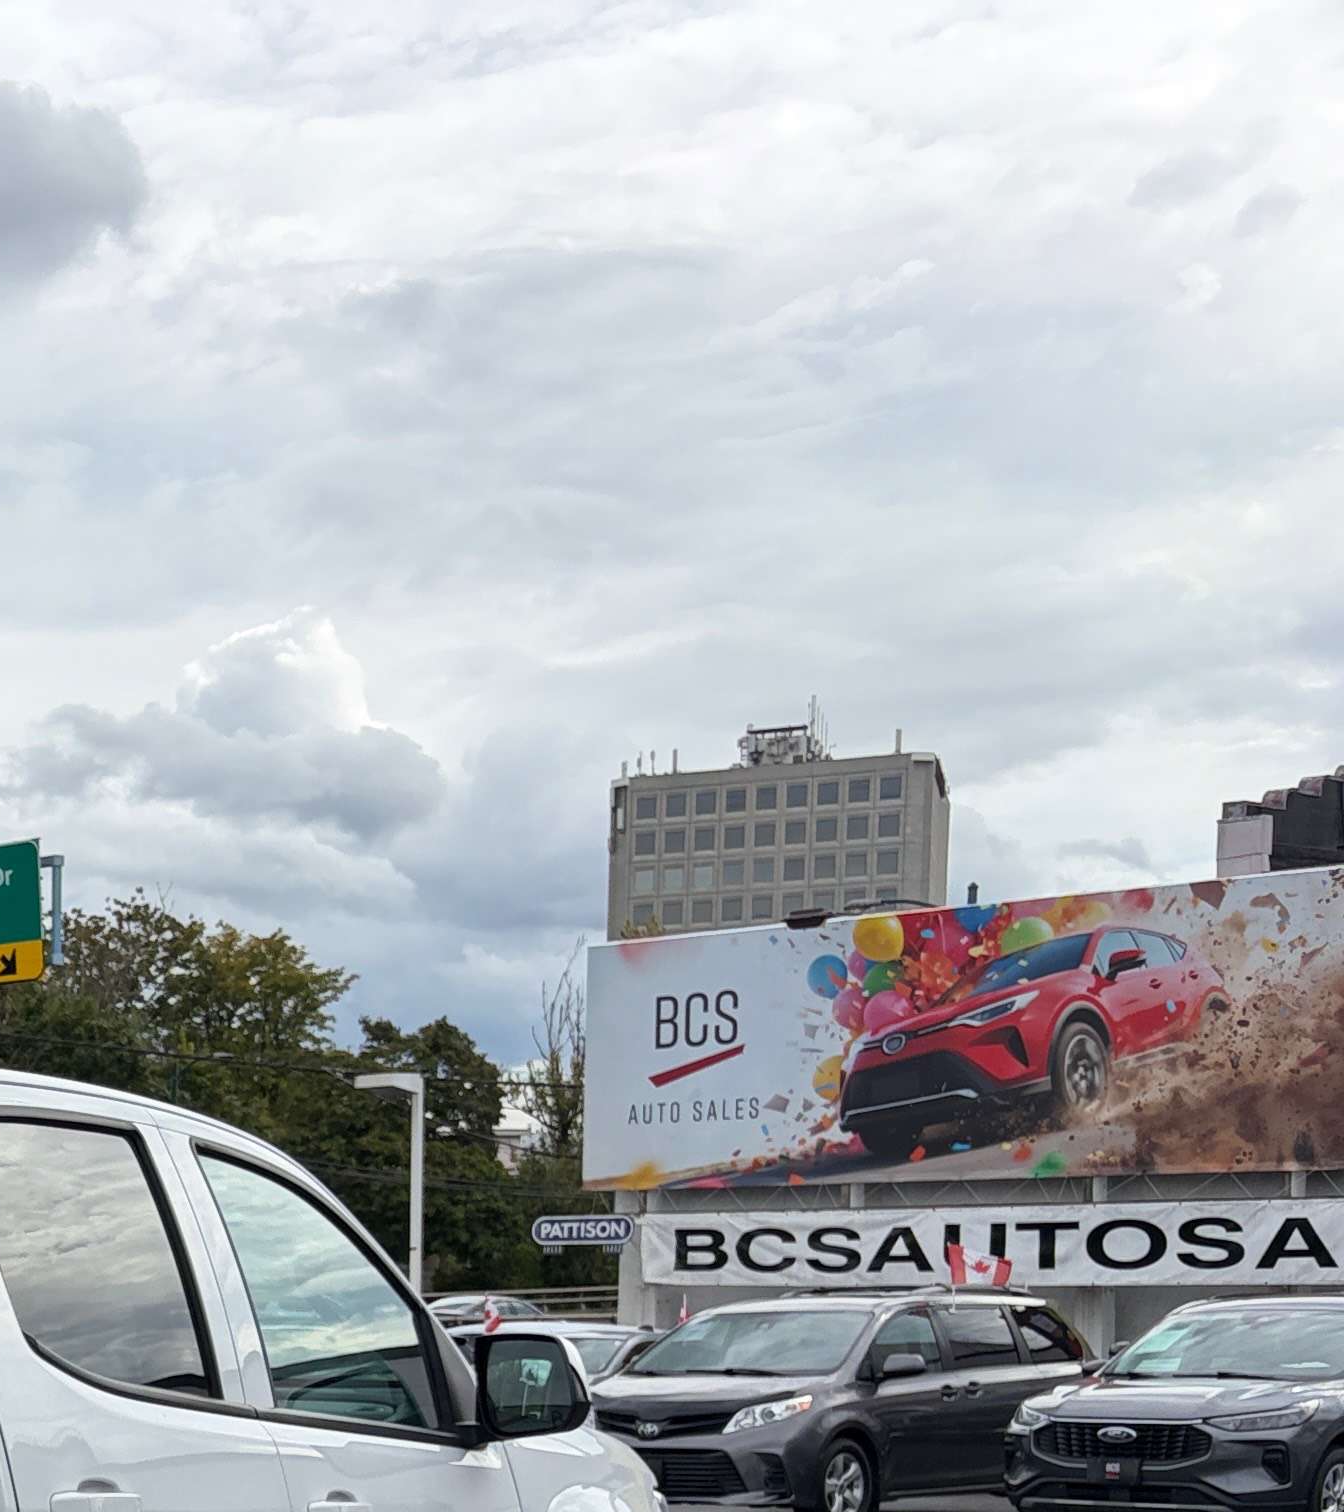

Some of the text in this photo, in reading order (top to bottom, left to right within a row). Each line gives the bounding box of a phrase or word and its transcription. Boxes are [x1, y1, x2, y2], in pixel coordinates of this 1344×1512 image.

[654, 989, 739, 1049] BCS
[628, 1096, 761, 1124] AUTO SALES
[540, 1219, 626, 1238] PATTISON
